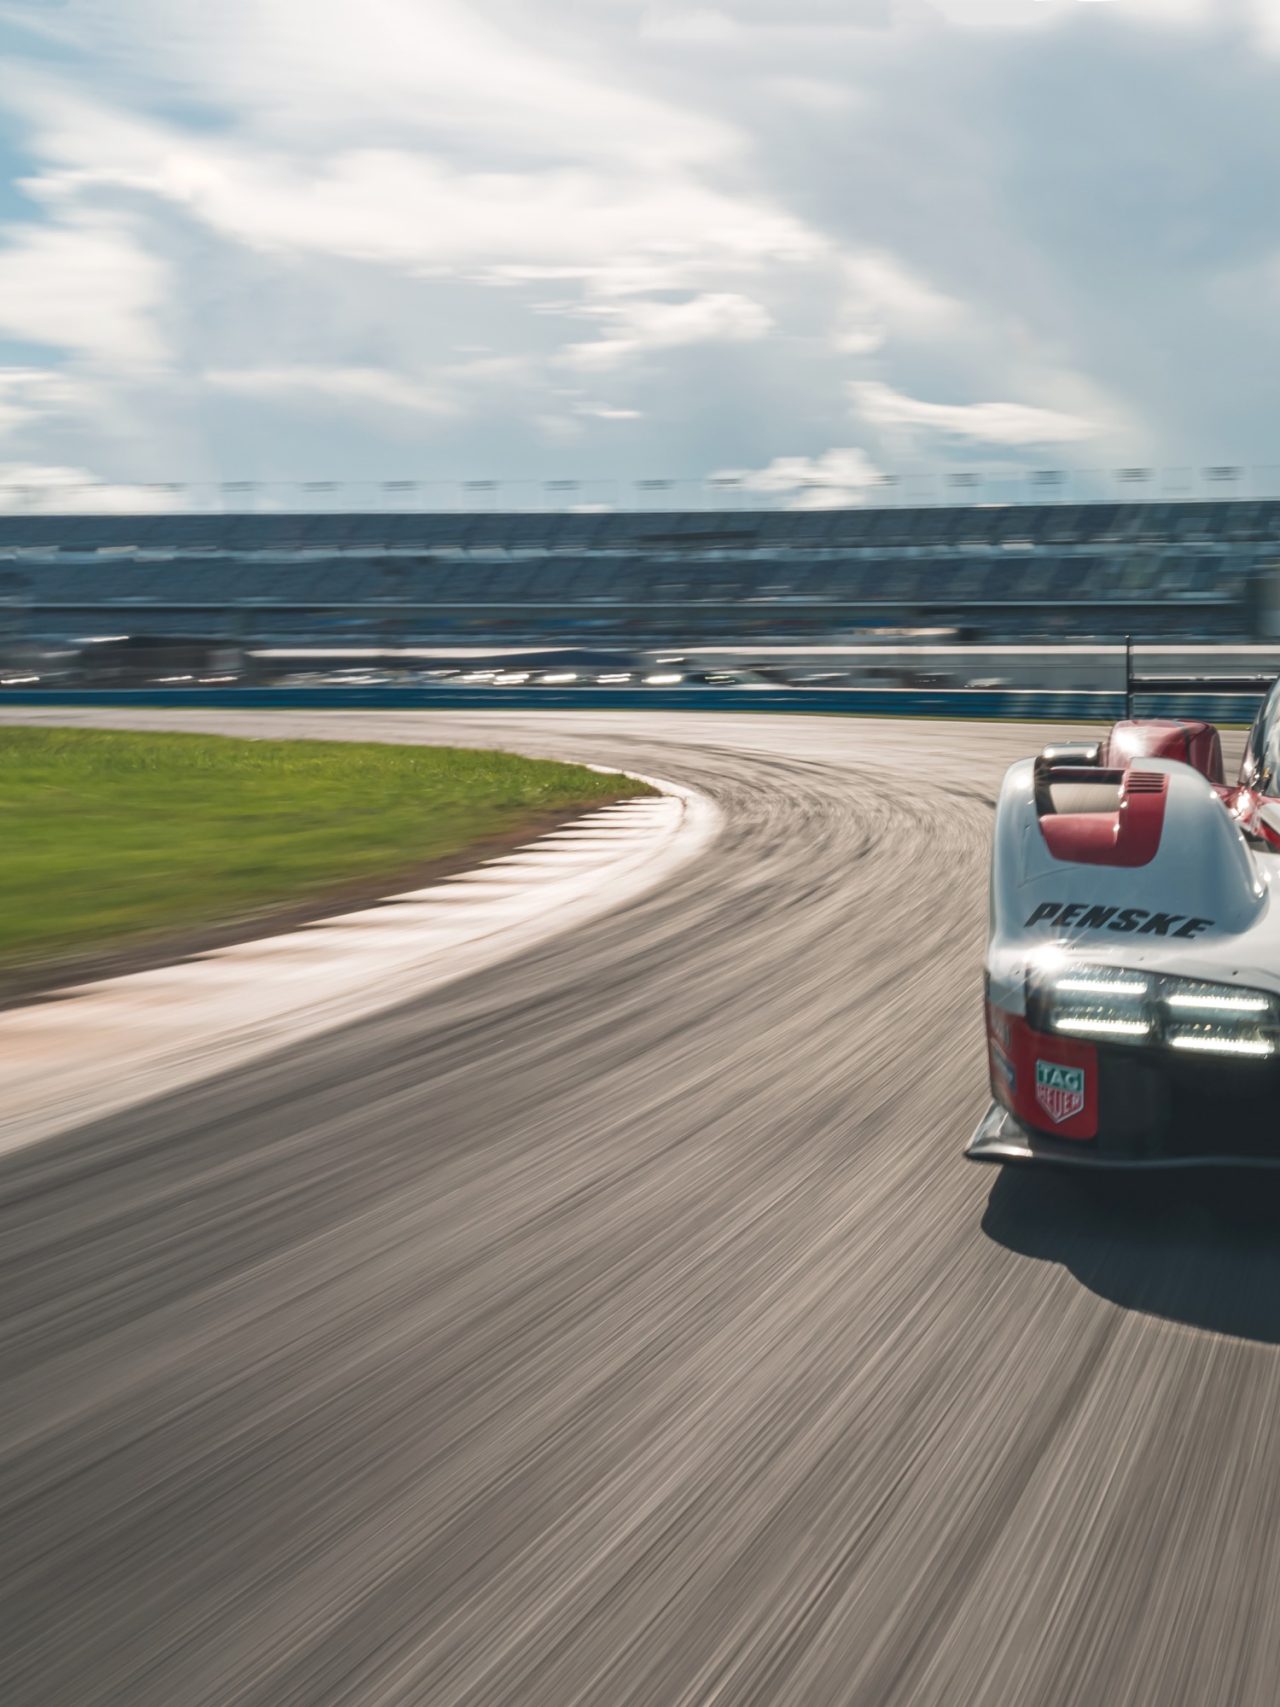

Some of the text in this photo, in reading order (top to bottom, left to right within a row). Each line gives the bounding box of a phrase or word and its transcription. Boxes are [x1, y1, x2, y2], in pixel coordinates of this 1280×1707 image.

[1023, 902, 1216, 939] PENSKE
[1038, 1068, 1079, 1090] TAG
[1037, 1086, 1082, 1118] HEUER
